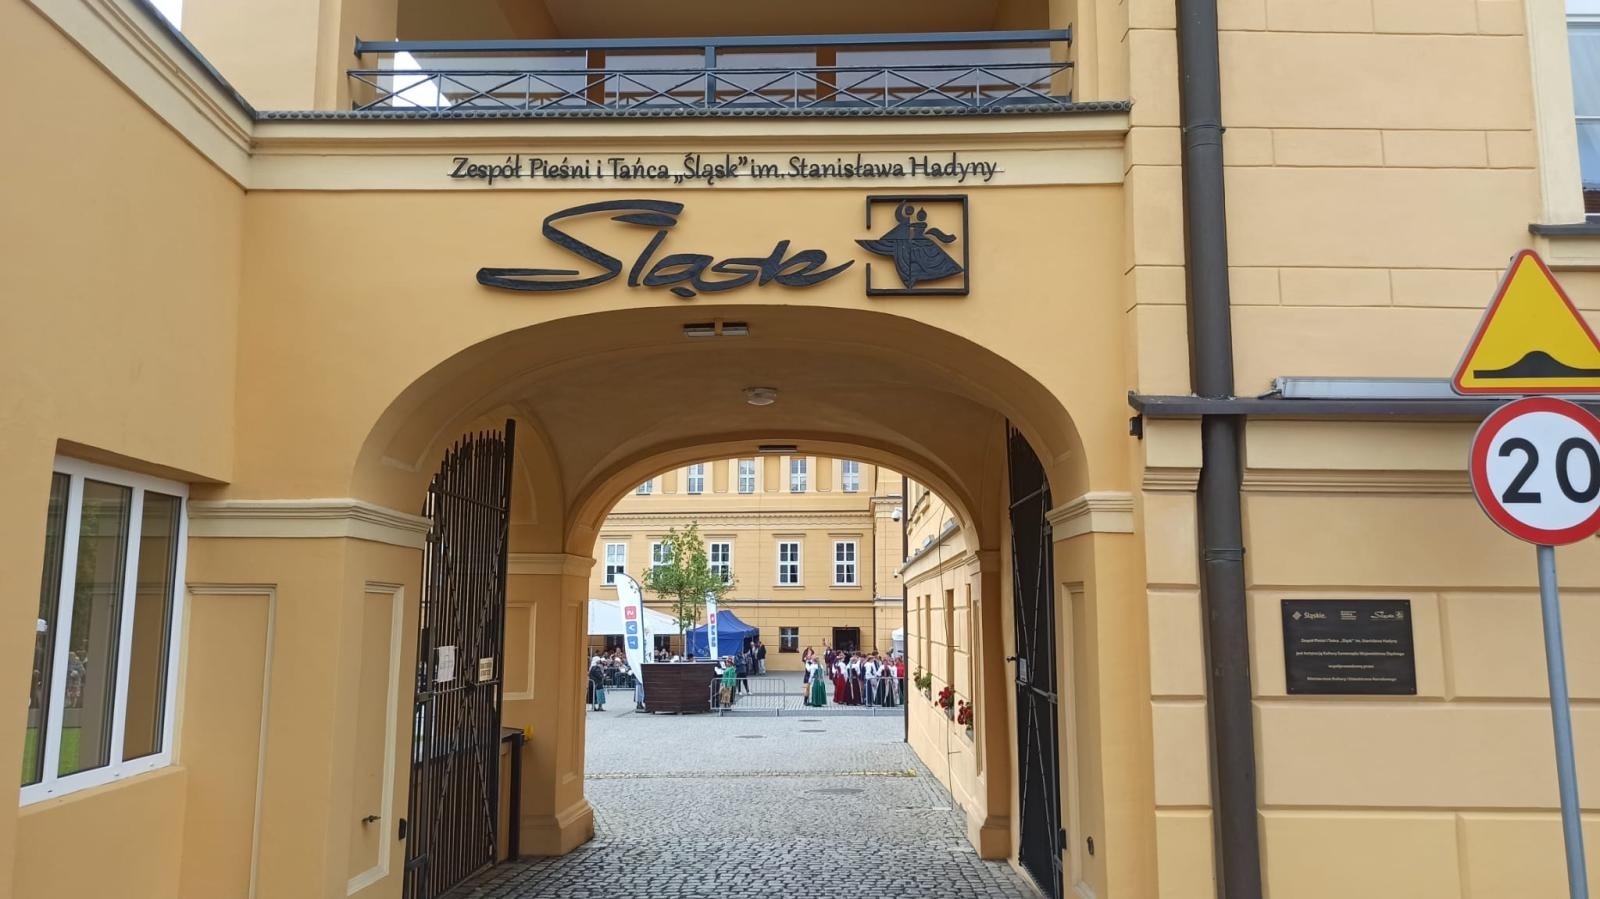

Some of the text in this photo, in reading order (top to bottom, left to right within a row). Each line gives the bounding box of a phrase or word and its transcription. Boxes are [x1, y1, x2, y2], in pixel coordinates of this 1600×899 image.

[450, 154, 522, 185] Zespół
[528, 157, 591, 180] Pieśni
[596, 159, 603, 179] i
[607, 156, 670, 180] Tańca
[788, 153, 905, 179] Stanisława
[908, 152, 997, 183] Hadyny
[1498, 437, 1600, 503] 20
